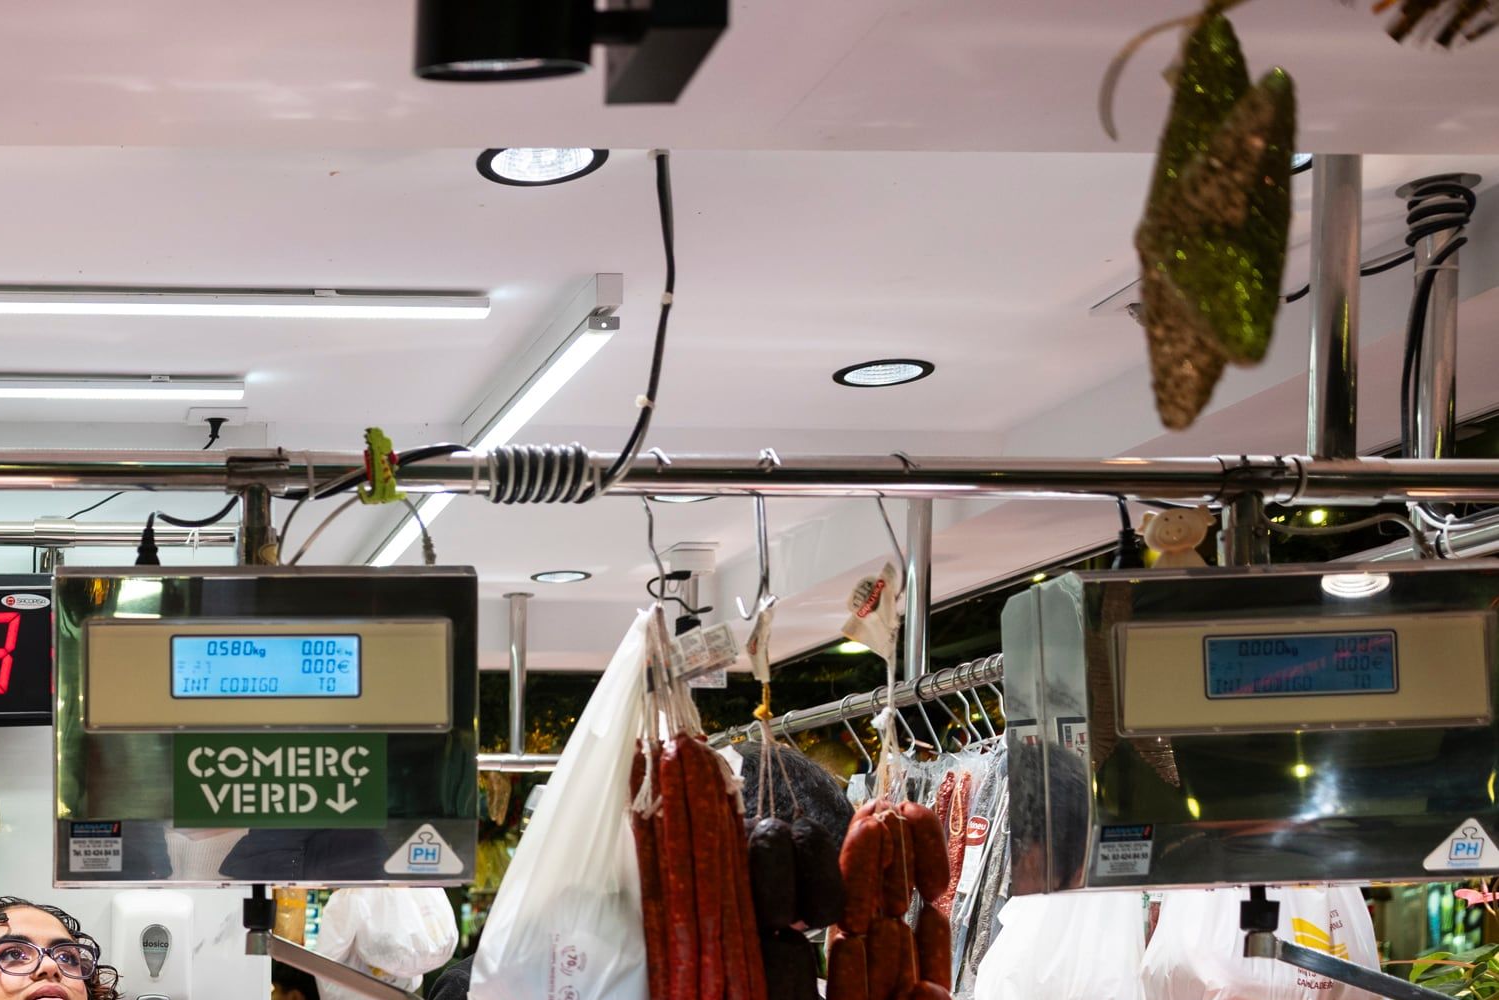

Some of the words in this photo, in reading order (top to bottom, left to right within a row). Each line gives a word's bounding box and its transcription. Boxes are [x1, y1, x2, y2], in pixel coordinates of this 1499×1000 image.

[220, 677, 279, 693] CODIGO
[187, 746, 370, 787] COMERÇ
[199, 785, 318, 815] VERD
[413, 847, 437, 861] PH
[1454, 842, 1479, 856] PH
[143, 939, 169, 948] dosico
